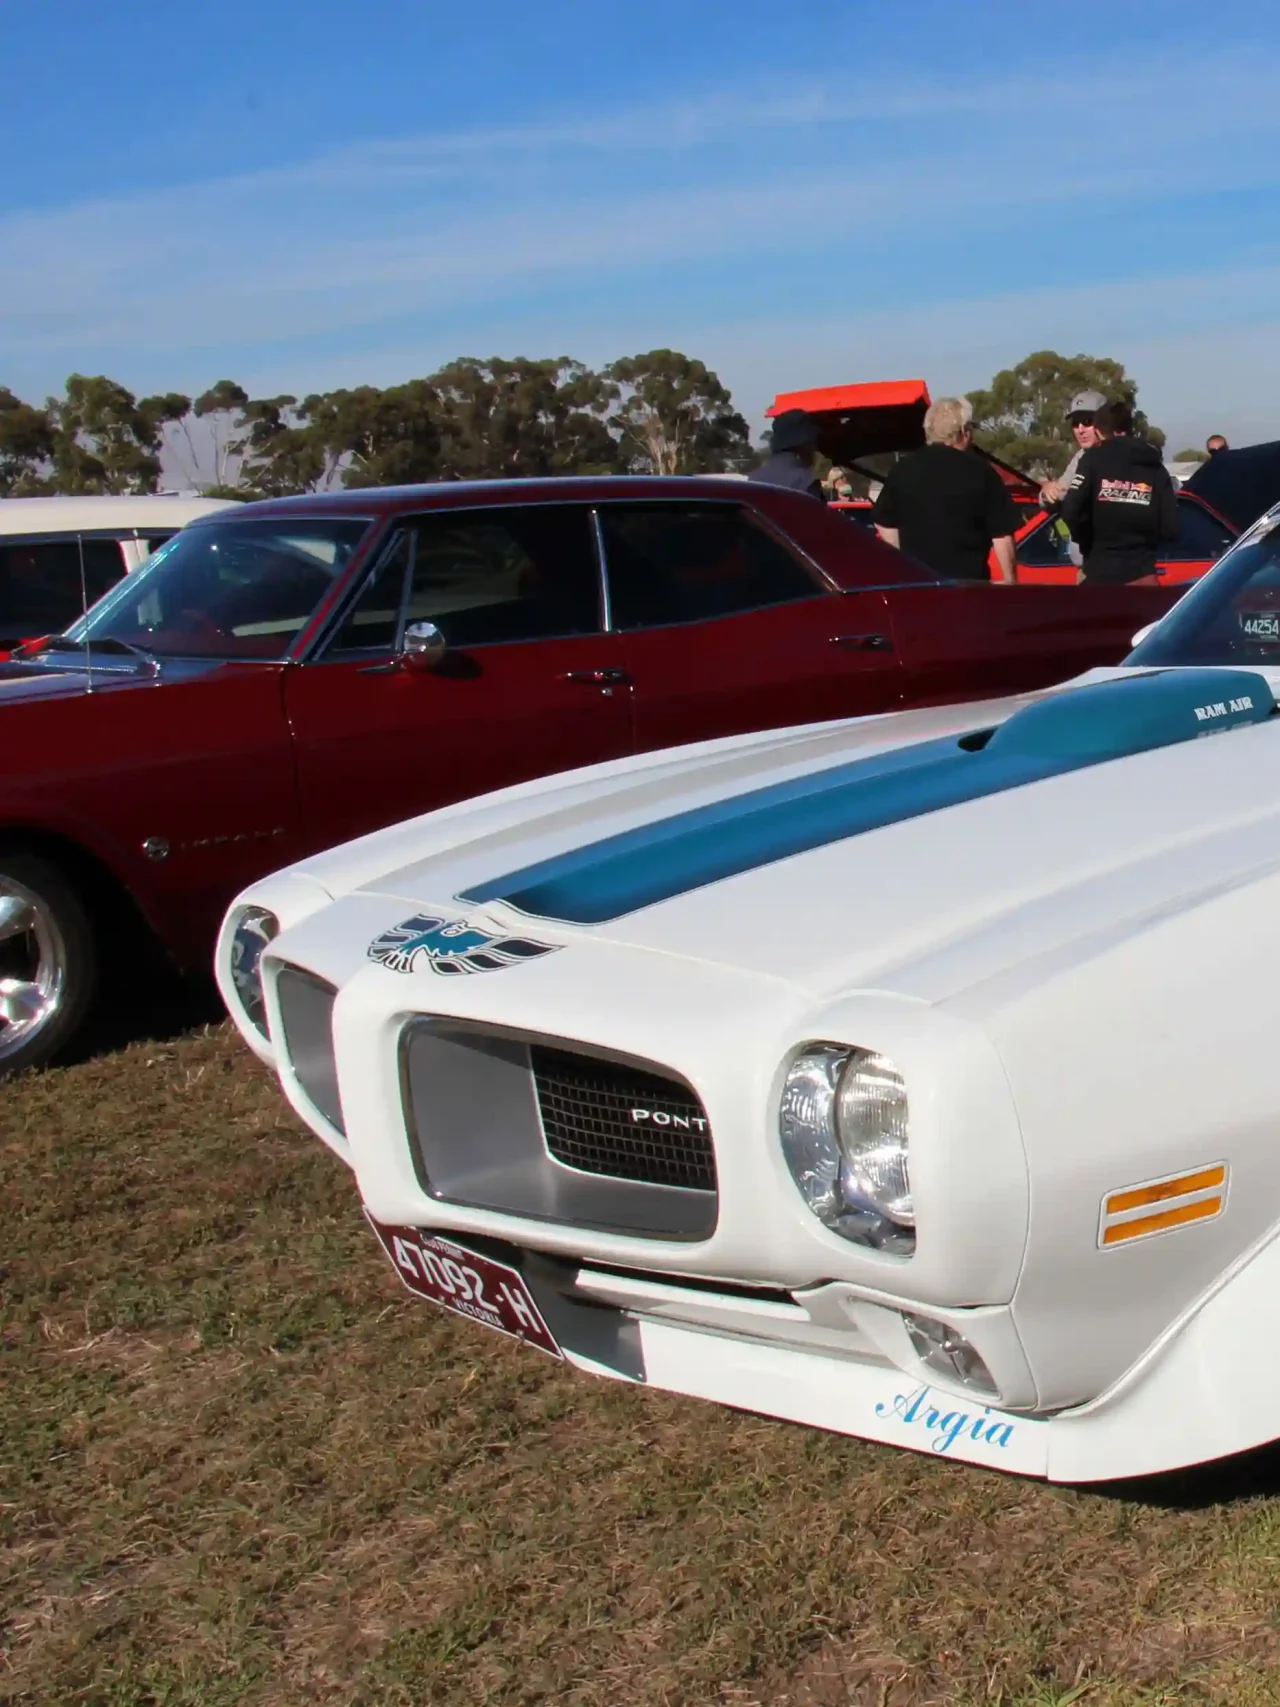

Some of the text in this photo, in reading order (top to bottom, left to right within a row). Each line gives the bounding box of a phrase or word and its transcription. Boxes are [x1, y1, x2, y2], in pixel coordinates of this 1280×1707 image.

[1099, 488, 1151, 501] RACING
[1194, 696, 1254, 721] RAM AIR
[631, 1109, 707, 1131] PONT
[451, 1296, 505, 1328] VICTORIA
[875, 1383, 1015, 1453] Argia
